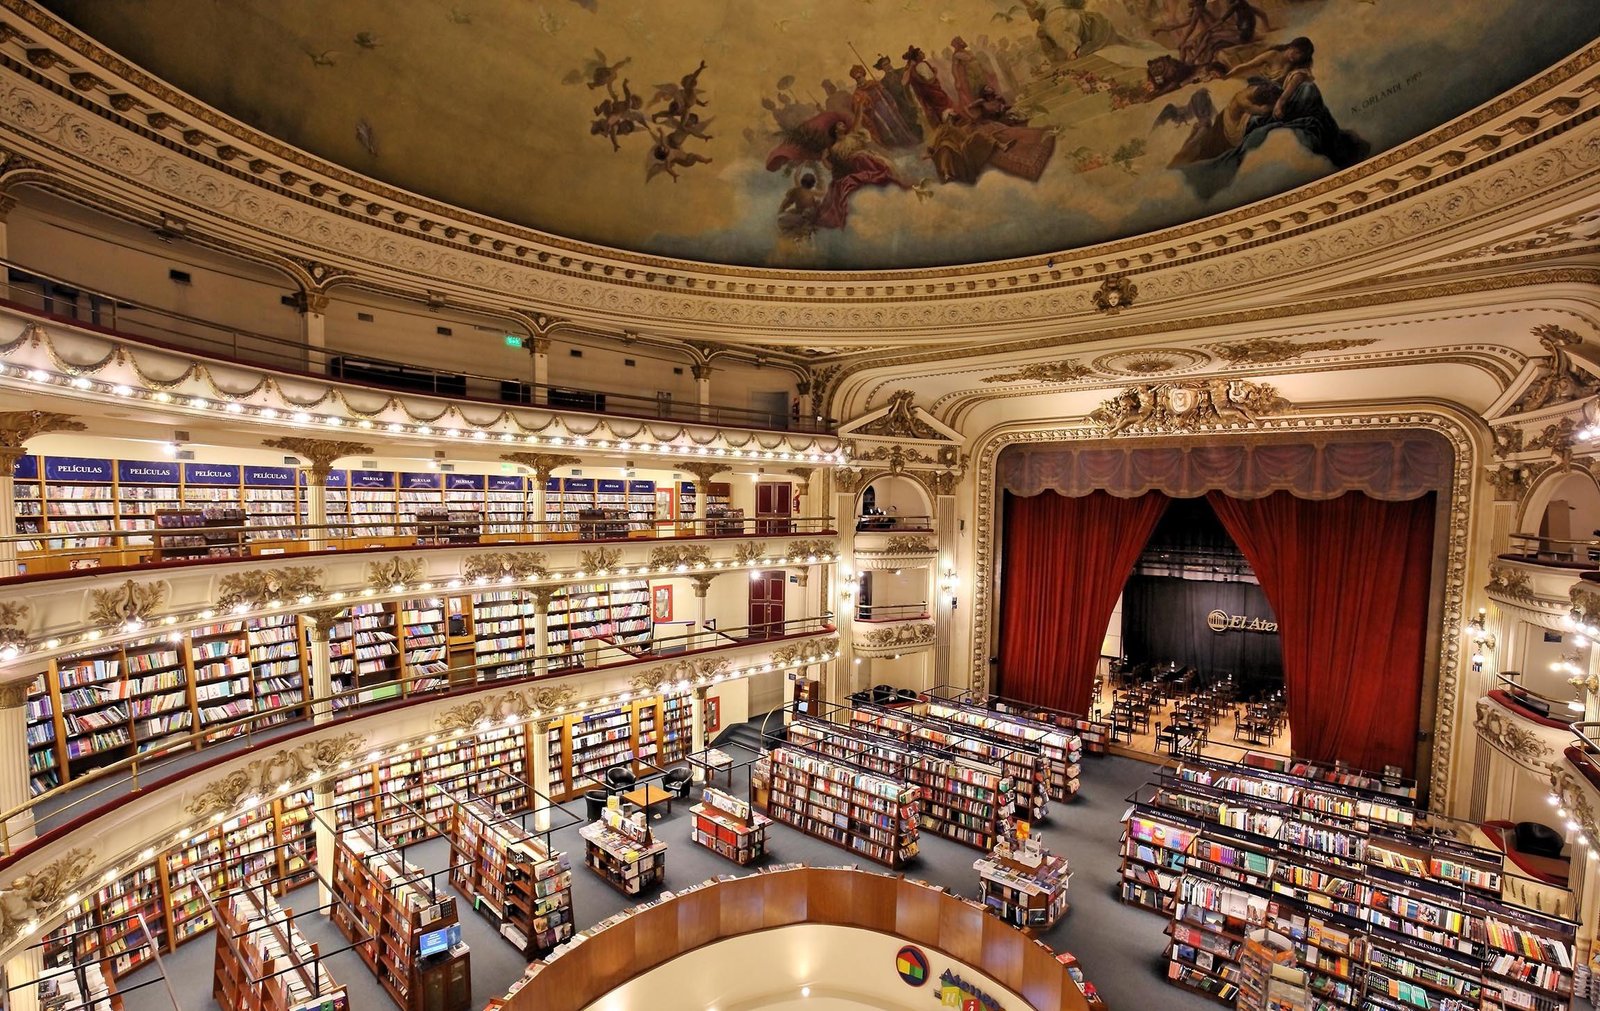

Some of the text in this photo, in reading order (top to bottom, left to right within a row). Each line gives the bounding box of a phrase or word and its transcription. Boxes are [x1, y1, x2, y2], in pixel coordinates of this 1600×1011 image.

[1362, 82, 1402, 108] ORLANDI
[57, 465, 103, 474] PELÍCULAS
[130, 467, 171, 476] PELÍCULAS
[195, 469, 232, 478] PELÍCULAS
[253, 472, 288, 480] PELÍCULAS
[1228, 615, 1248, 630] El
[1313, 784, 1349, 796] ARQUITECTURA
[1161, 812, 1188, 824] ARGENTINO
[1233, 832, 1248, 840] ARTE
[1459, 849, 1475, 857] CINE
[1216, 876, 1241, 888] TURISMO
[1404, 879, 1420, 888] ARTE
[1305, 904, 1335, 918] TURISMO
[1509, 910, 1527, 919] ARTE
[1408, 939, 1442, 953] TURISMO
